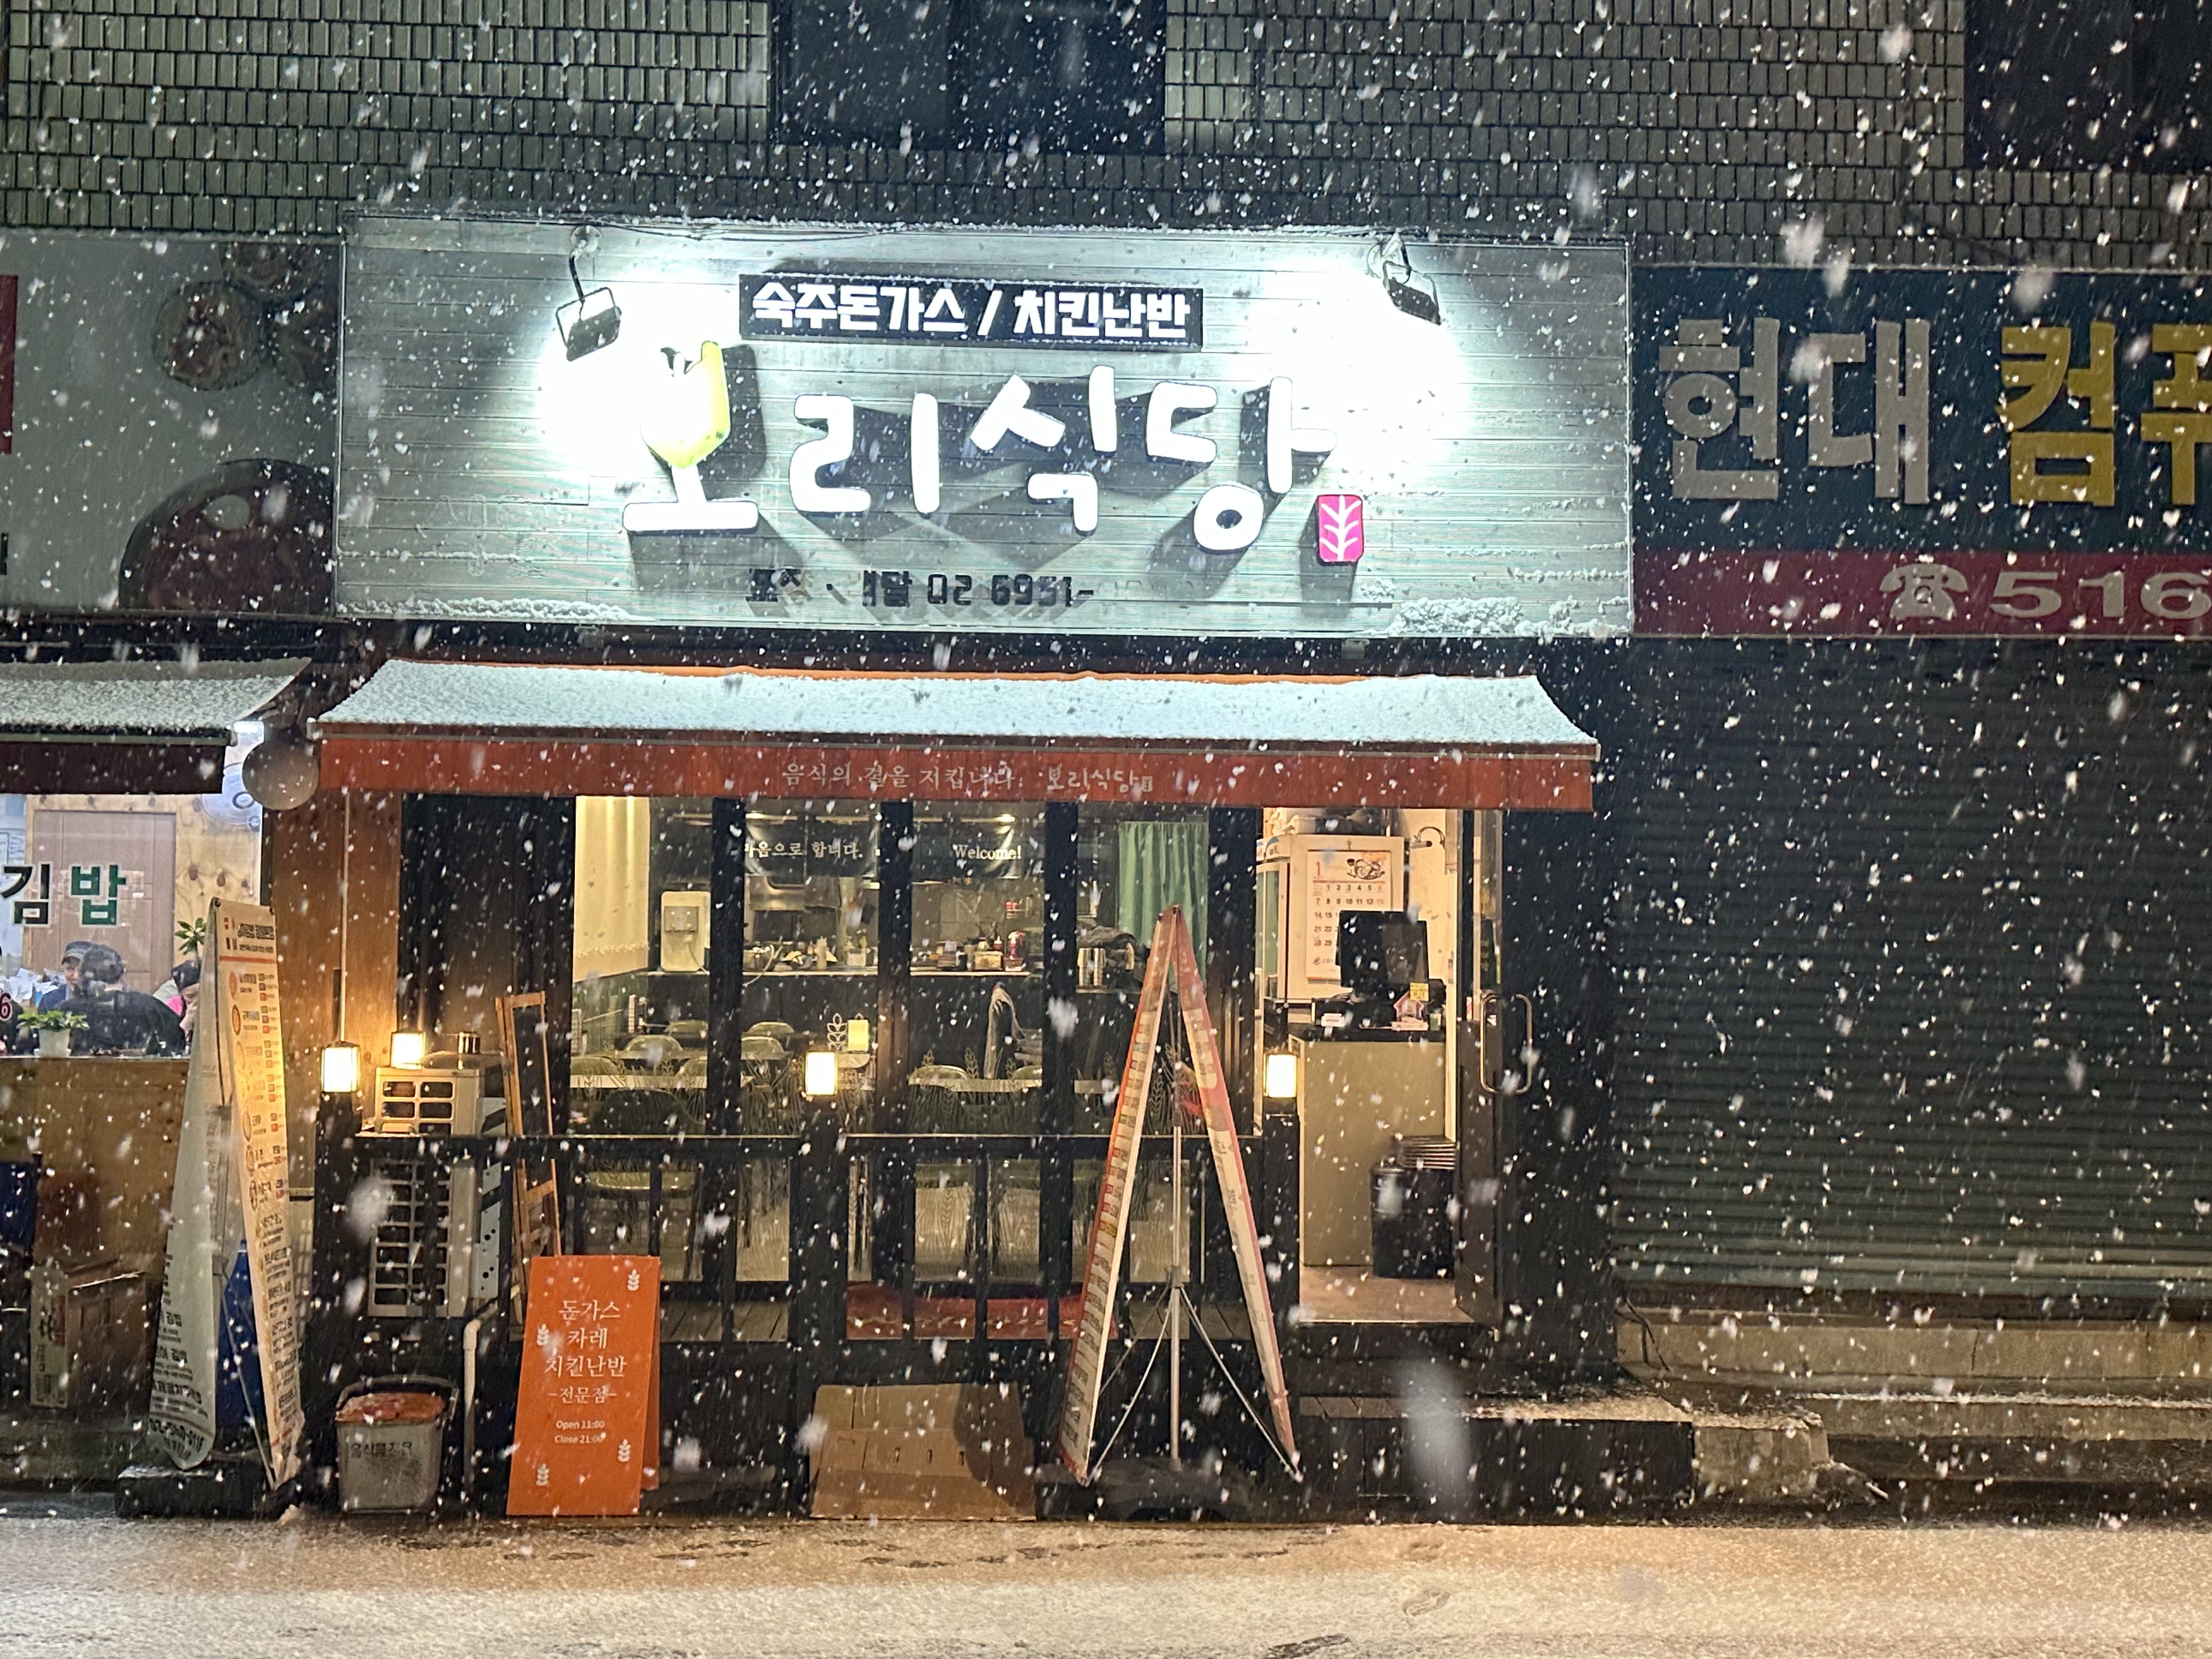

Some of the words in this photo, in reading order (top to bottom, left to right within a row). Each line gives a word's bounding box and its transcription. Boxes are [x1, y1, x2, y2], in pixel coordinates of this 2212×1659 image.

[753, 282, 966, 332] 숙주돈가스
[1014, 289, 1190, 338] 치킨난반
[1658, 318, 1930, 505] 현대
[928, 574, 972, 606] 02
[1990, 571, 2212, 620] 516
[782, 763, 850, 787] 음식의
[1047, 763, 1139, 793] 보리식당
[811, 840, 864, 860] 합니다.
[952, 844, 1022, 860] Welcome!
[558, 1299, 621, 1321] 돈가스
[567, 1327, 608, 1349] 카레
[544, 1355, 627, 1378] 치킨난반
[555, 1420, 579, 1430] Open
[580, 1420, 605, 1429] 11:00
[554, 1435, 578, 1443] Close
